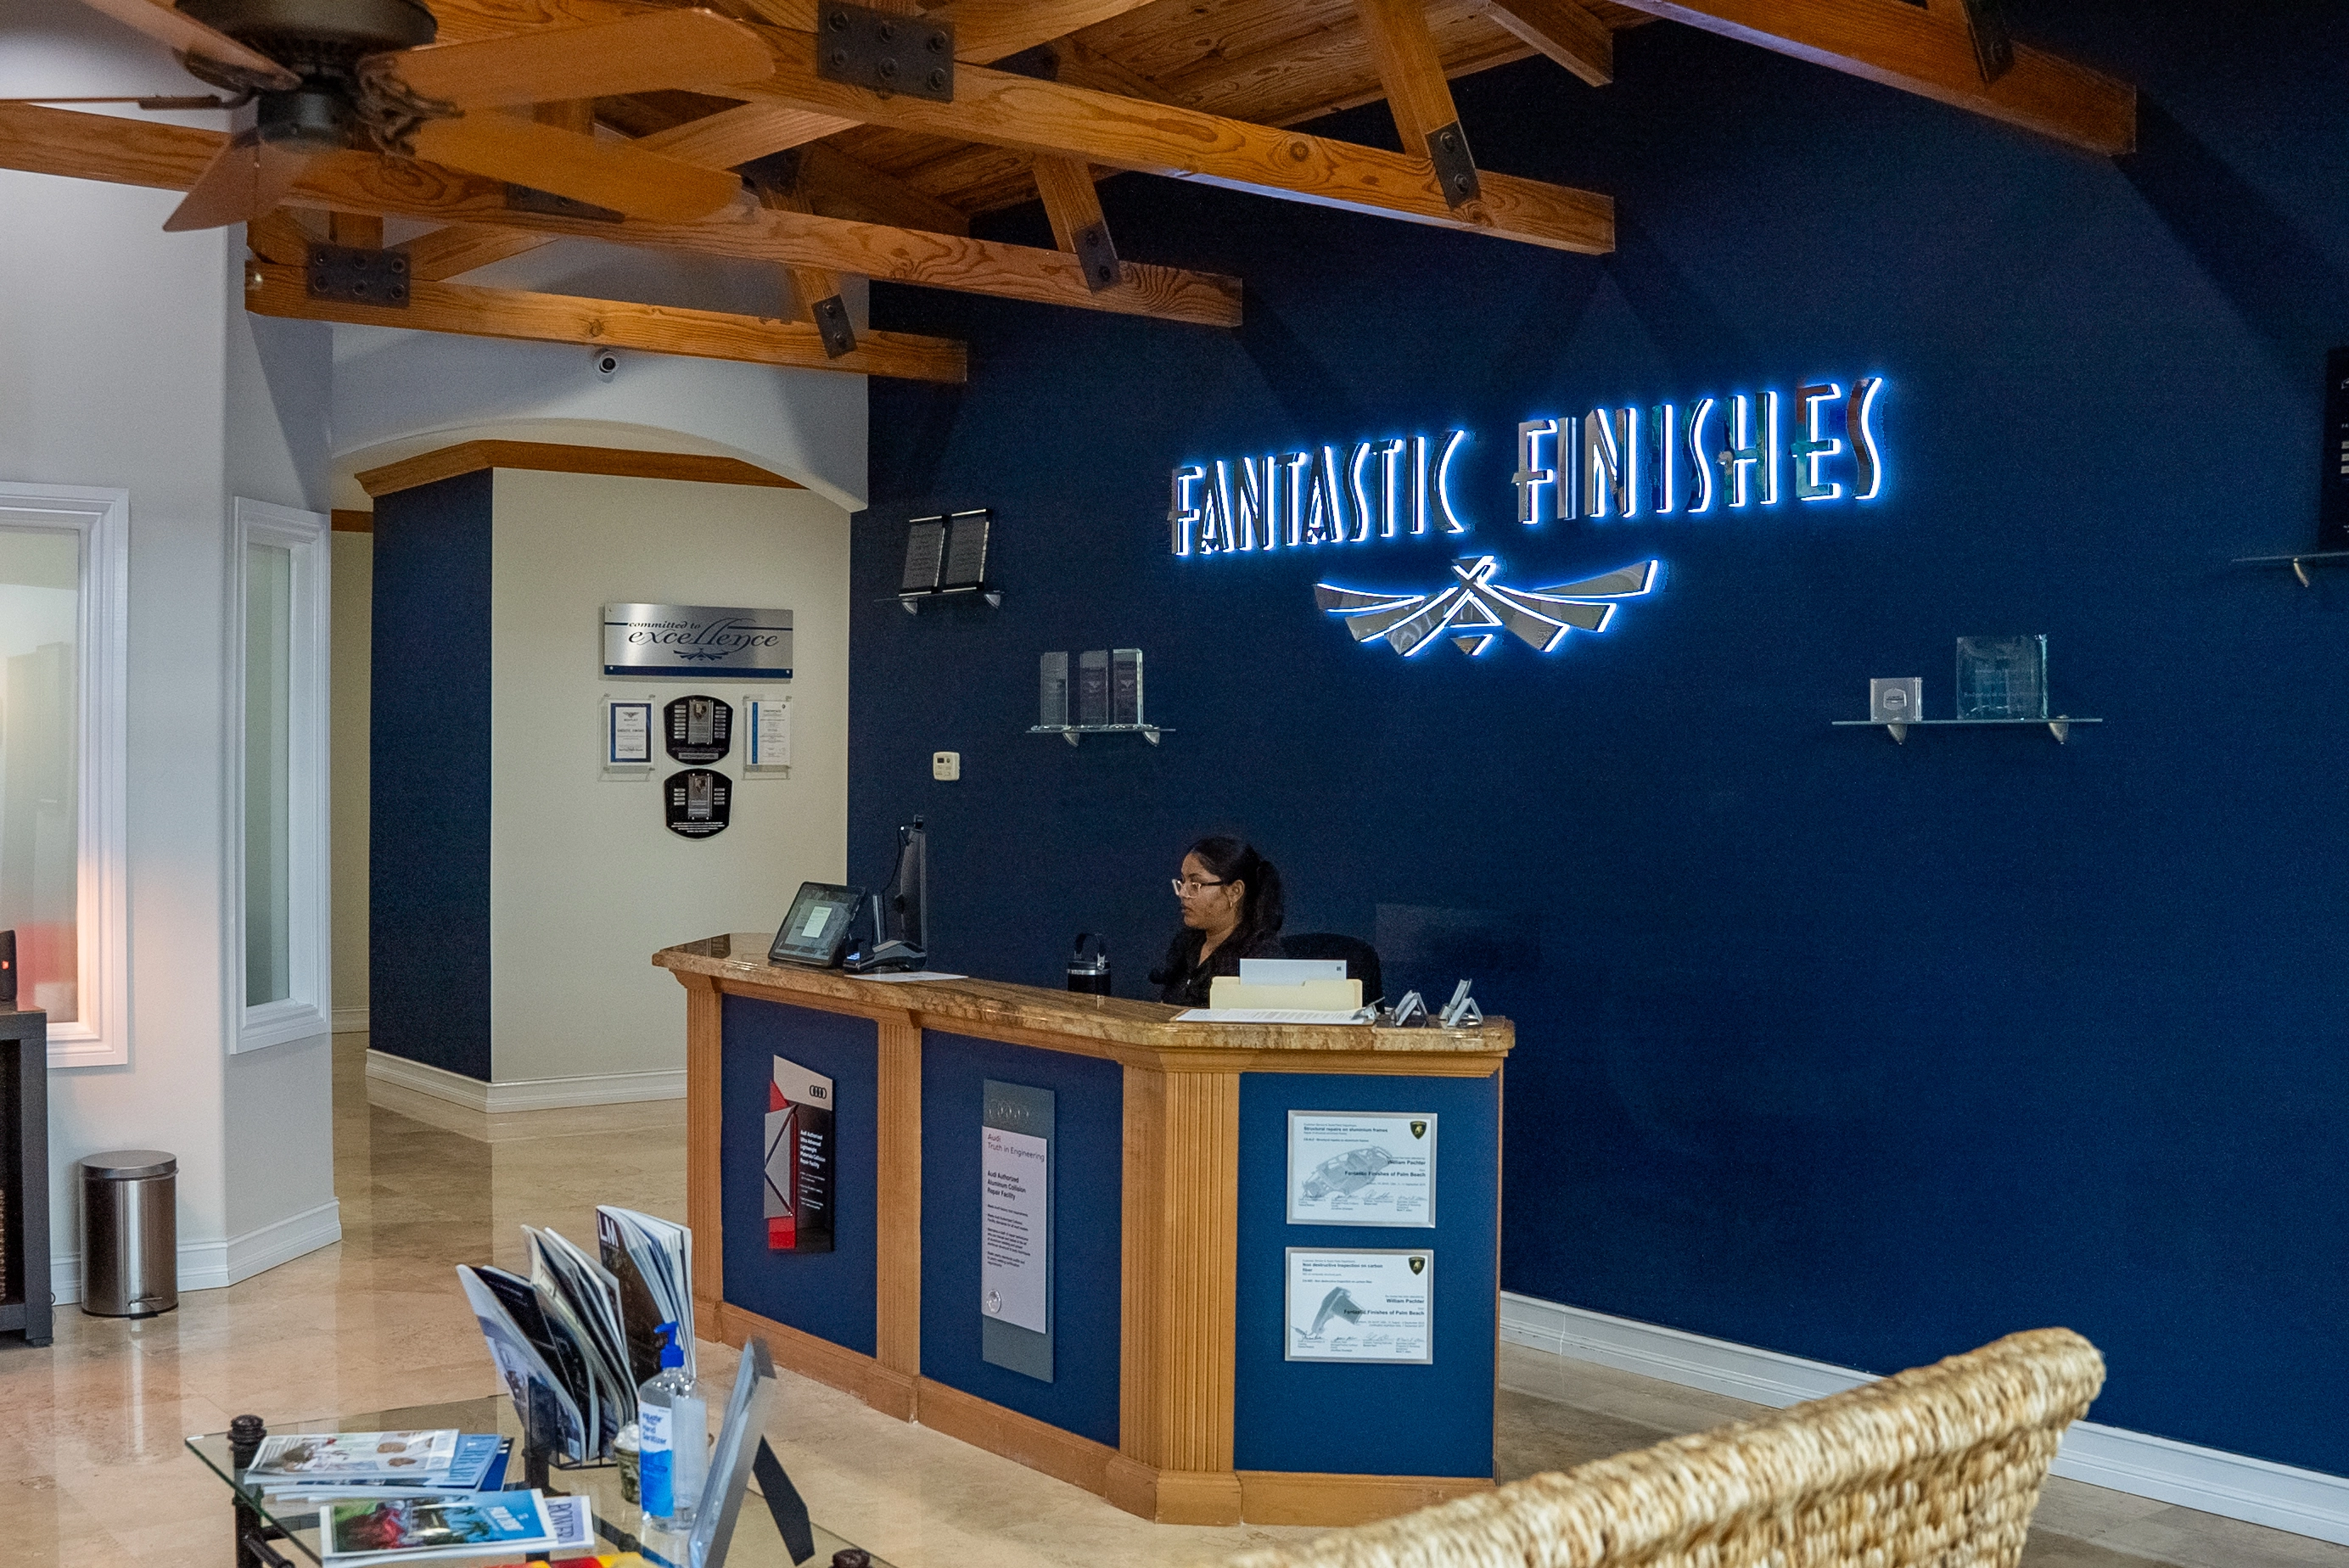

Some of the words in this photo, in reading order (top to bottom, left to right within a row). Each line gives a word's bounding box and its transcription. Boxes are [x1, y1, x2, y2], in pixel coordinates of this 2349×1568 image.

[1168, 429, 1467, 557] FANTASTIC
[1510, 376, 1884, 524] FINISHES
[628, 618, 780, 653] excellence
[629, 620, 687, 630] committed
[988, 1141, 1002, 1152] Truth
[1010, 1146, 1045, 1162] Engineering
